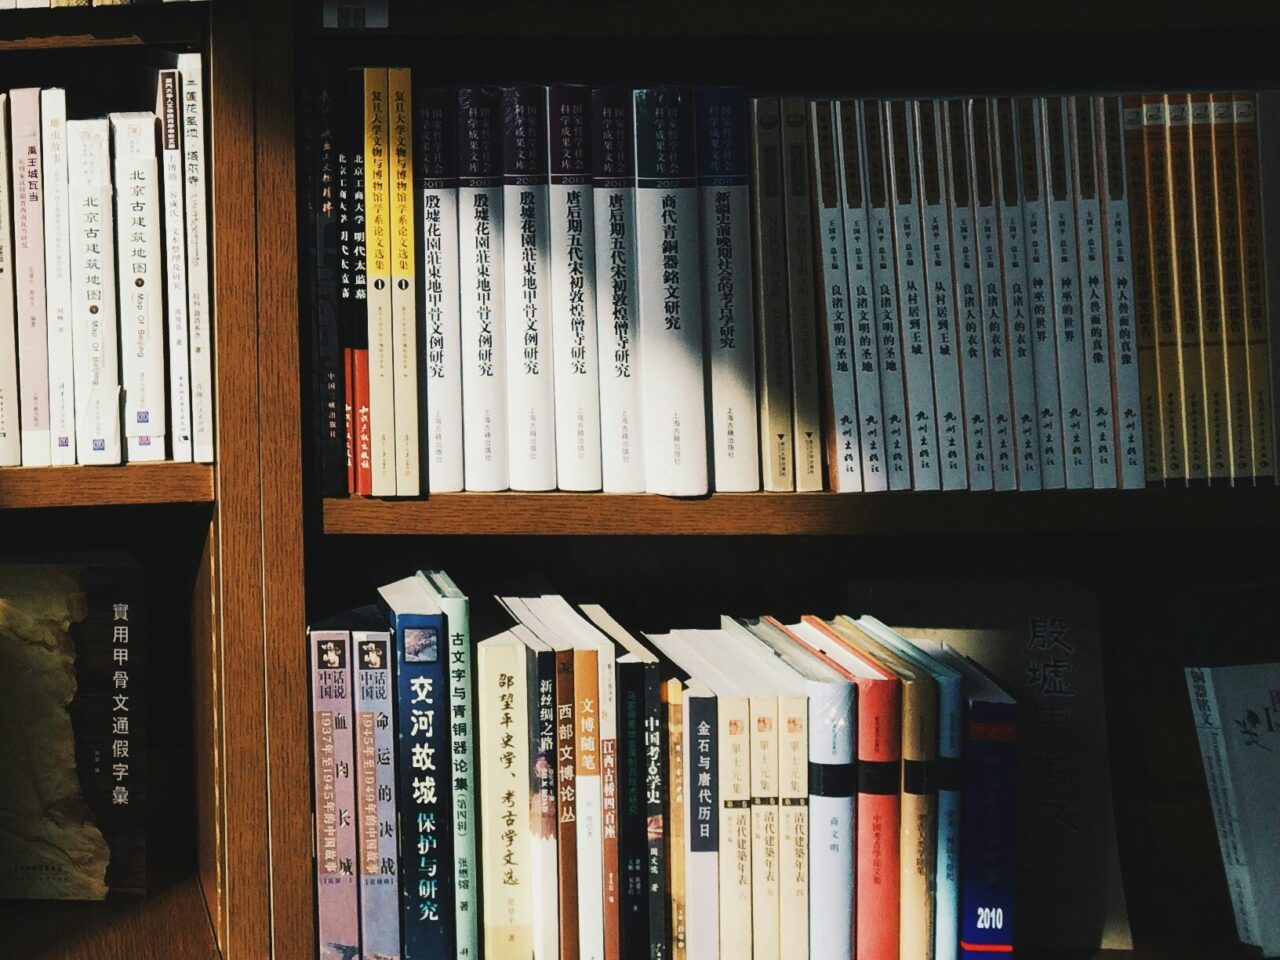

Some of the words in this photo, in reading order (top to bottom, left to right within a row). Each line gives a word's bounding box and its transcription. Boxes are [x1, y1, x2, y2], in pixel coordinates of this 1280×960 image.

[129, 170, 147, 274] 北京古建筑地图
[371, 91, 385, 271] 复旦大学文物与博物馆学系论文选集
[395, 91, 409, 271] 复旦大学文物与博物馆学系论文选集
[82, 196, 102, 301] 北京古建筑地图
[565, 190, 586, 374] 唐后期五代宋初敦煌僧寺研究
[608, 194, 630, 378] 唐后期五代宋初敦煌僧寺研究
[661, 194, 681, 331] 商代青銅器銘文研究
[137, 330, 145, 358] Beijing
[832, 285, 849, 372] 良渚文明的圣地
[856, 285, 873, 372] 良渚文明的圣地
[880, 284, 897, 371] 良渚文明的圣地
[906, 280, 923, 355] 从村居到王城
[935, 281, 951, 356] 从村居到王城
[964, 284, 978, 358] 良渚人的衣食
[987, 283, 1002, 358] 良渚人的衣食
[1013, 283, 1027, 358] 良渚人的衣食
[1033, 277, 1046, 342] 神巫的世界
[1061, 278, 1074, 342] 神巫的世界
[1088, 275, 1104, 363] 神人兽面的真像
[1117, 277, 1132, 364] 神人兽面的真像
[112, 603, 129, 805] 實用甲骨文通假字彙
[320, 671, 331, 700] 中国
[333, 671, 345, 699] 话说
[361, 671, 374, 700] 中国
[374, 671, 387, 700] 话说
[451, 633, 468, 790] 古文字与青铜器论集
[540, 680, 553, 750] 新丝绸之路
[410, 676, 437, 804] 交河故城
[558, 704, 575, 823] 西部文博论丛
[581, 698, 596, 770] 文博随笔
[645, 717, 661, 804] 中国考古学史
[376, 713, 395, 875] 命运的决战
[697, 721, 711, 838] 金石与唐代历日
[417, 813, 439, 920] 保护与研究
[460, 901, 468, 911] 著
[976, 907, 1004, 929] 2010
